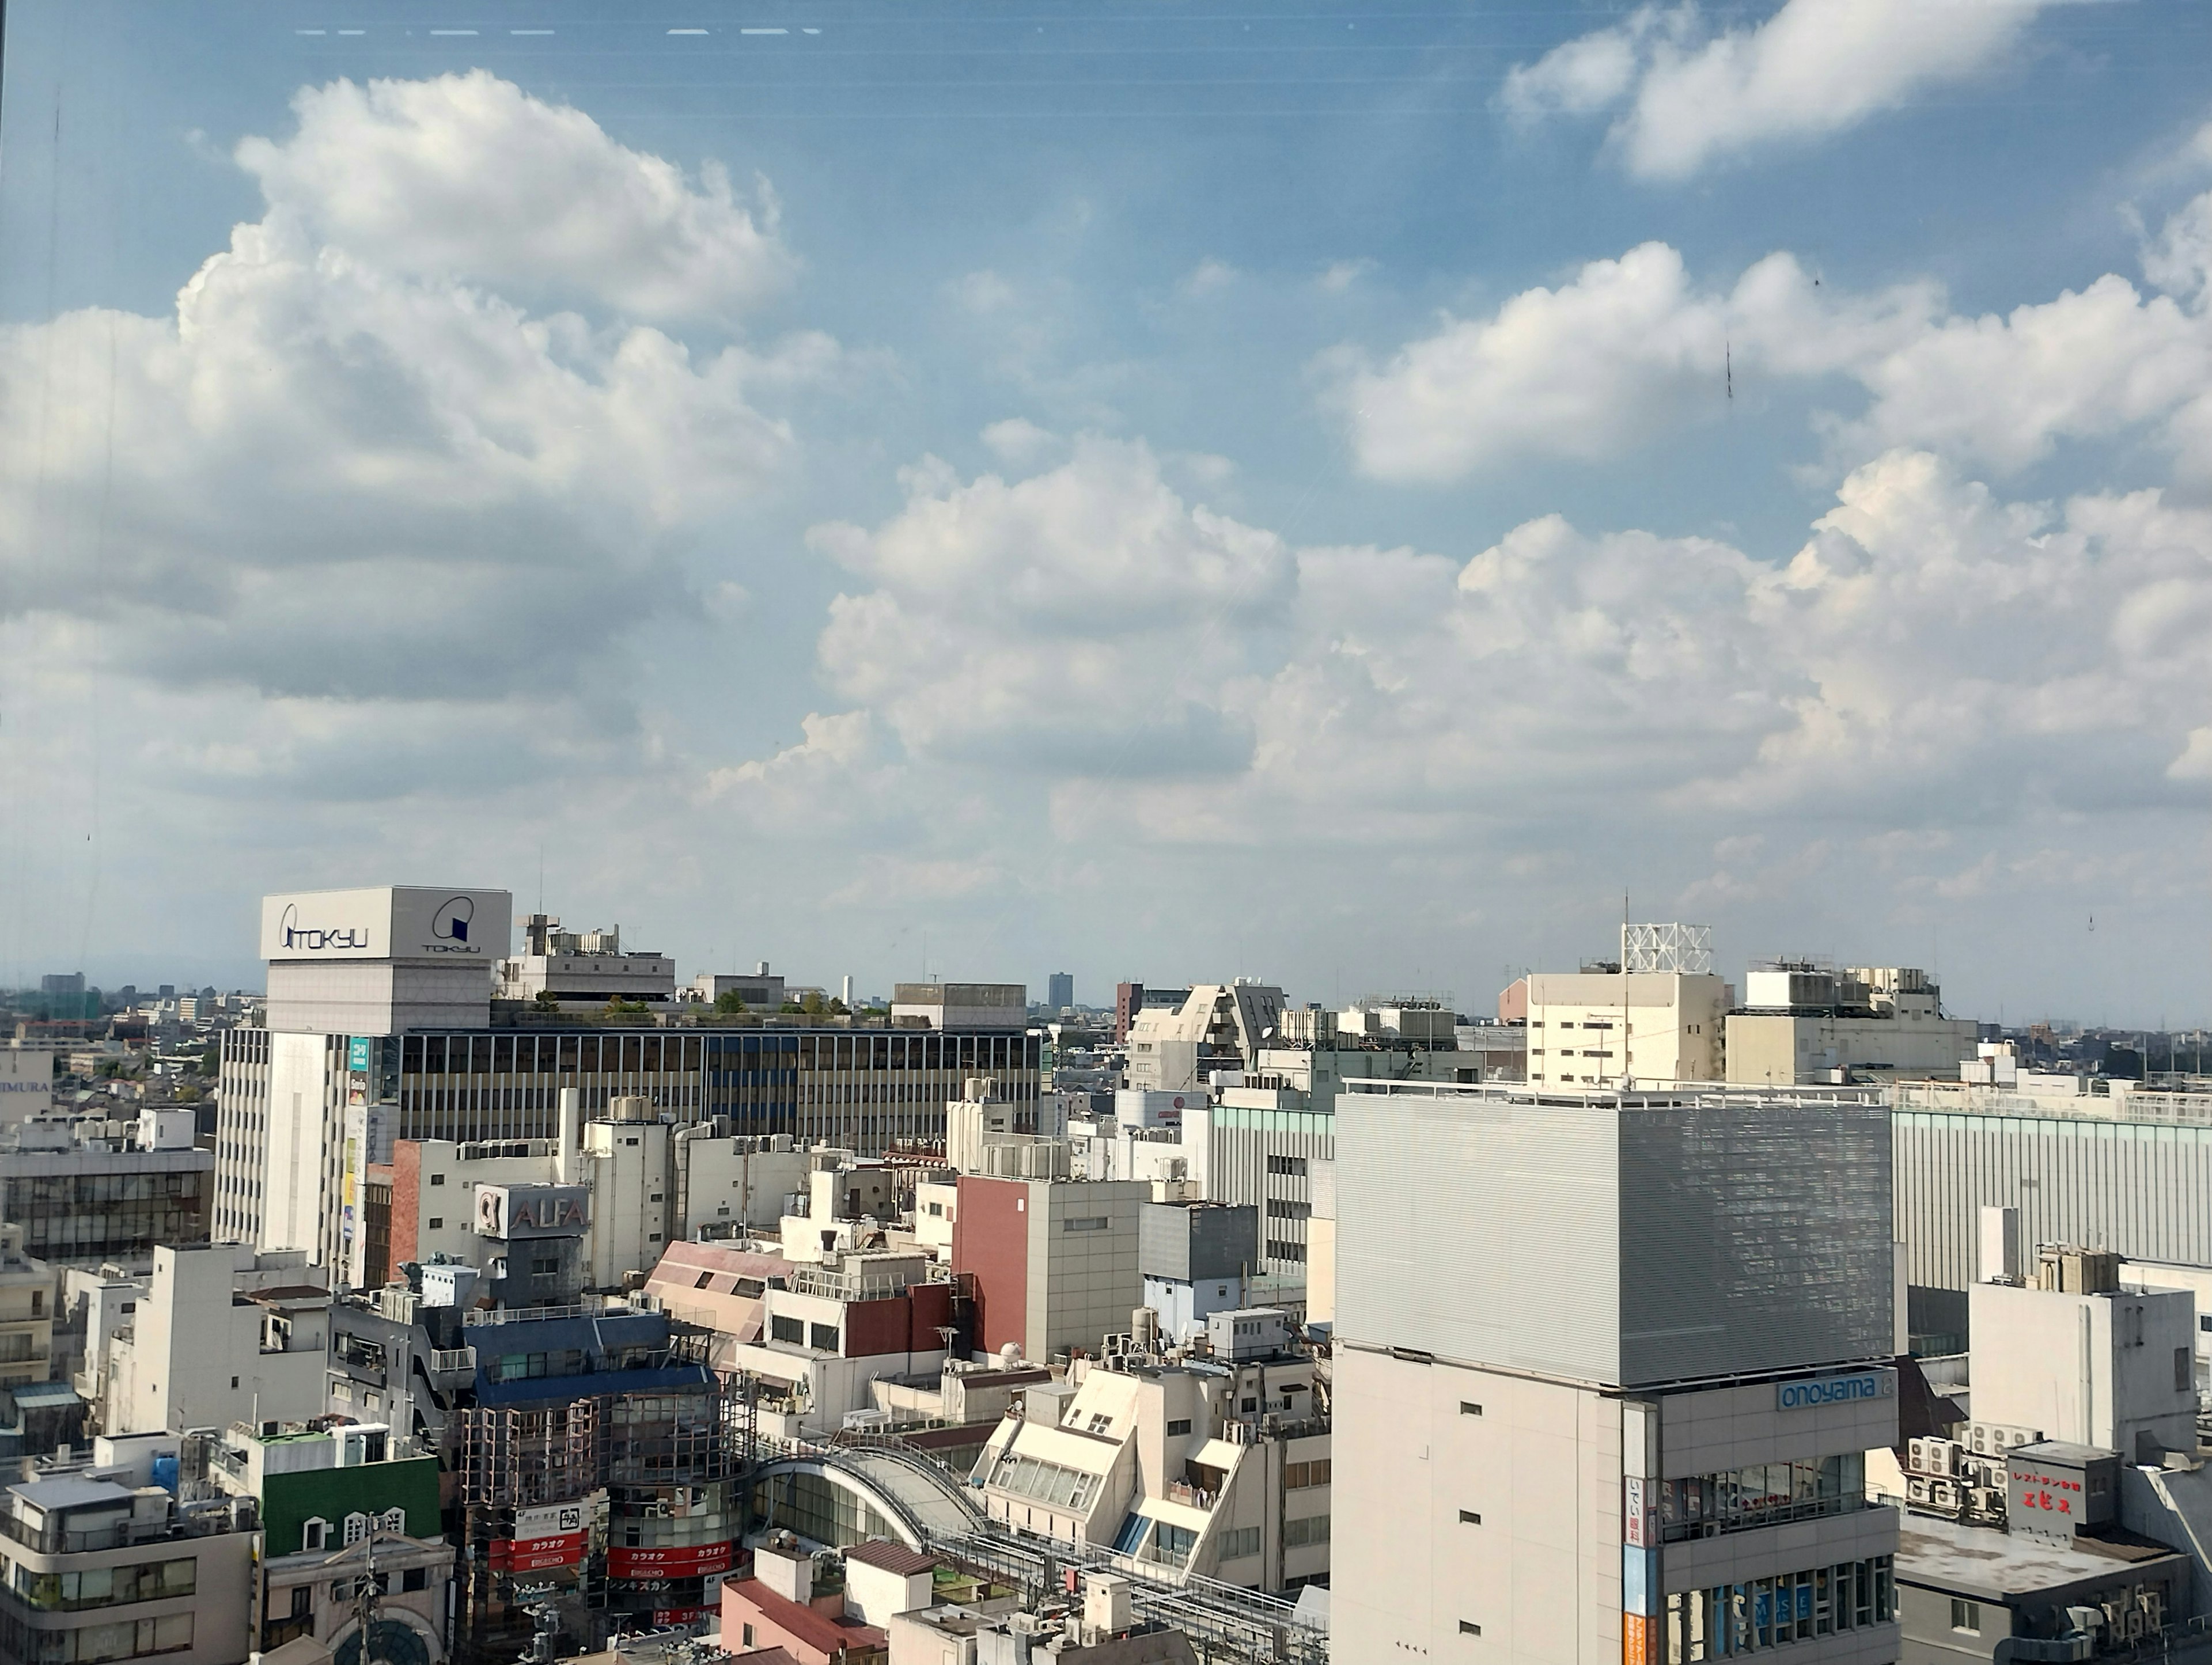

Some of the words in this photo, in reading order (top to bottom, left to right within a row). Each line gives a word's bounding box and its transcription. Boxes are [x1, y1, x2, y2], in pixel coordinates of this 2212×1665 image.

[294, 928, 369, 950] TOKYU
[421, 945, 480, 953] TOKYU
[0, 1082, 48, 1093] IMURA
[510, 1198, 589, 1230] ALFA
[1782, 1377, 1876, 1407] onoyama
[1630, 1479, 1640, 1543] いでい眼科
[531, 1539, 565, 1552] カラオケ
[631, 1552, 665, 1561] カラオケ
[698, 1546, 726, 1558] カラオケ
[706, 1576, 716, 1584] 4F
